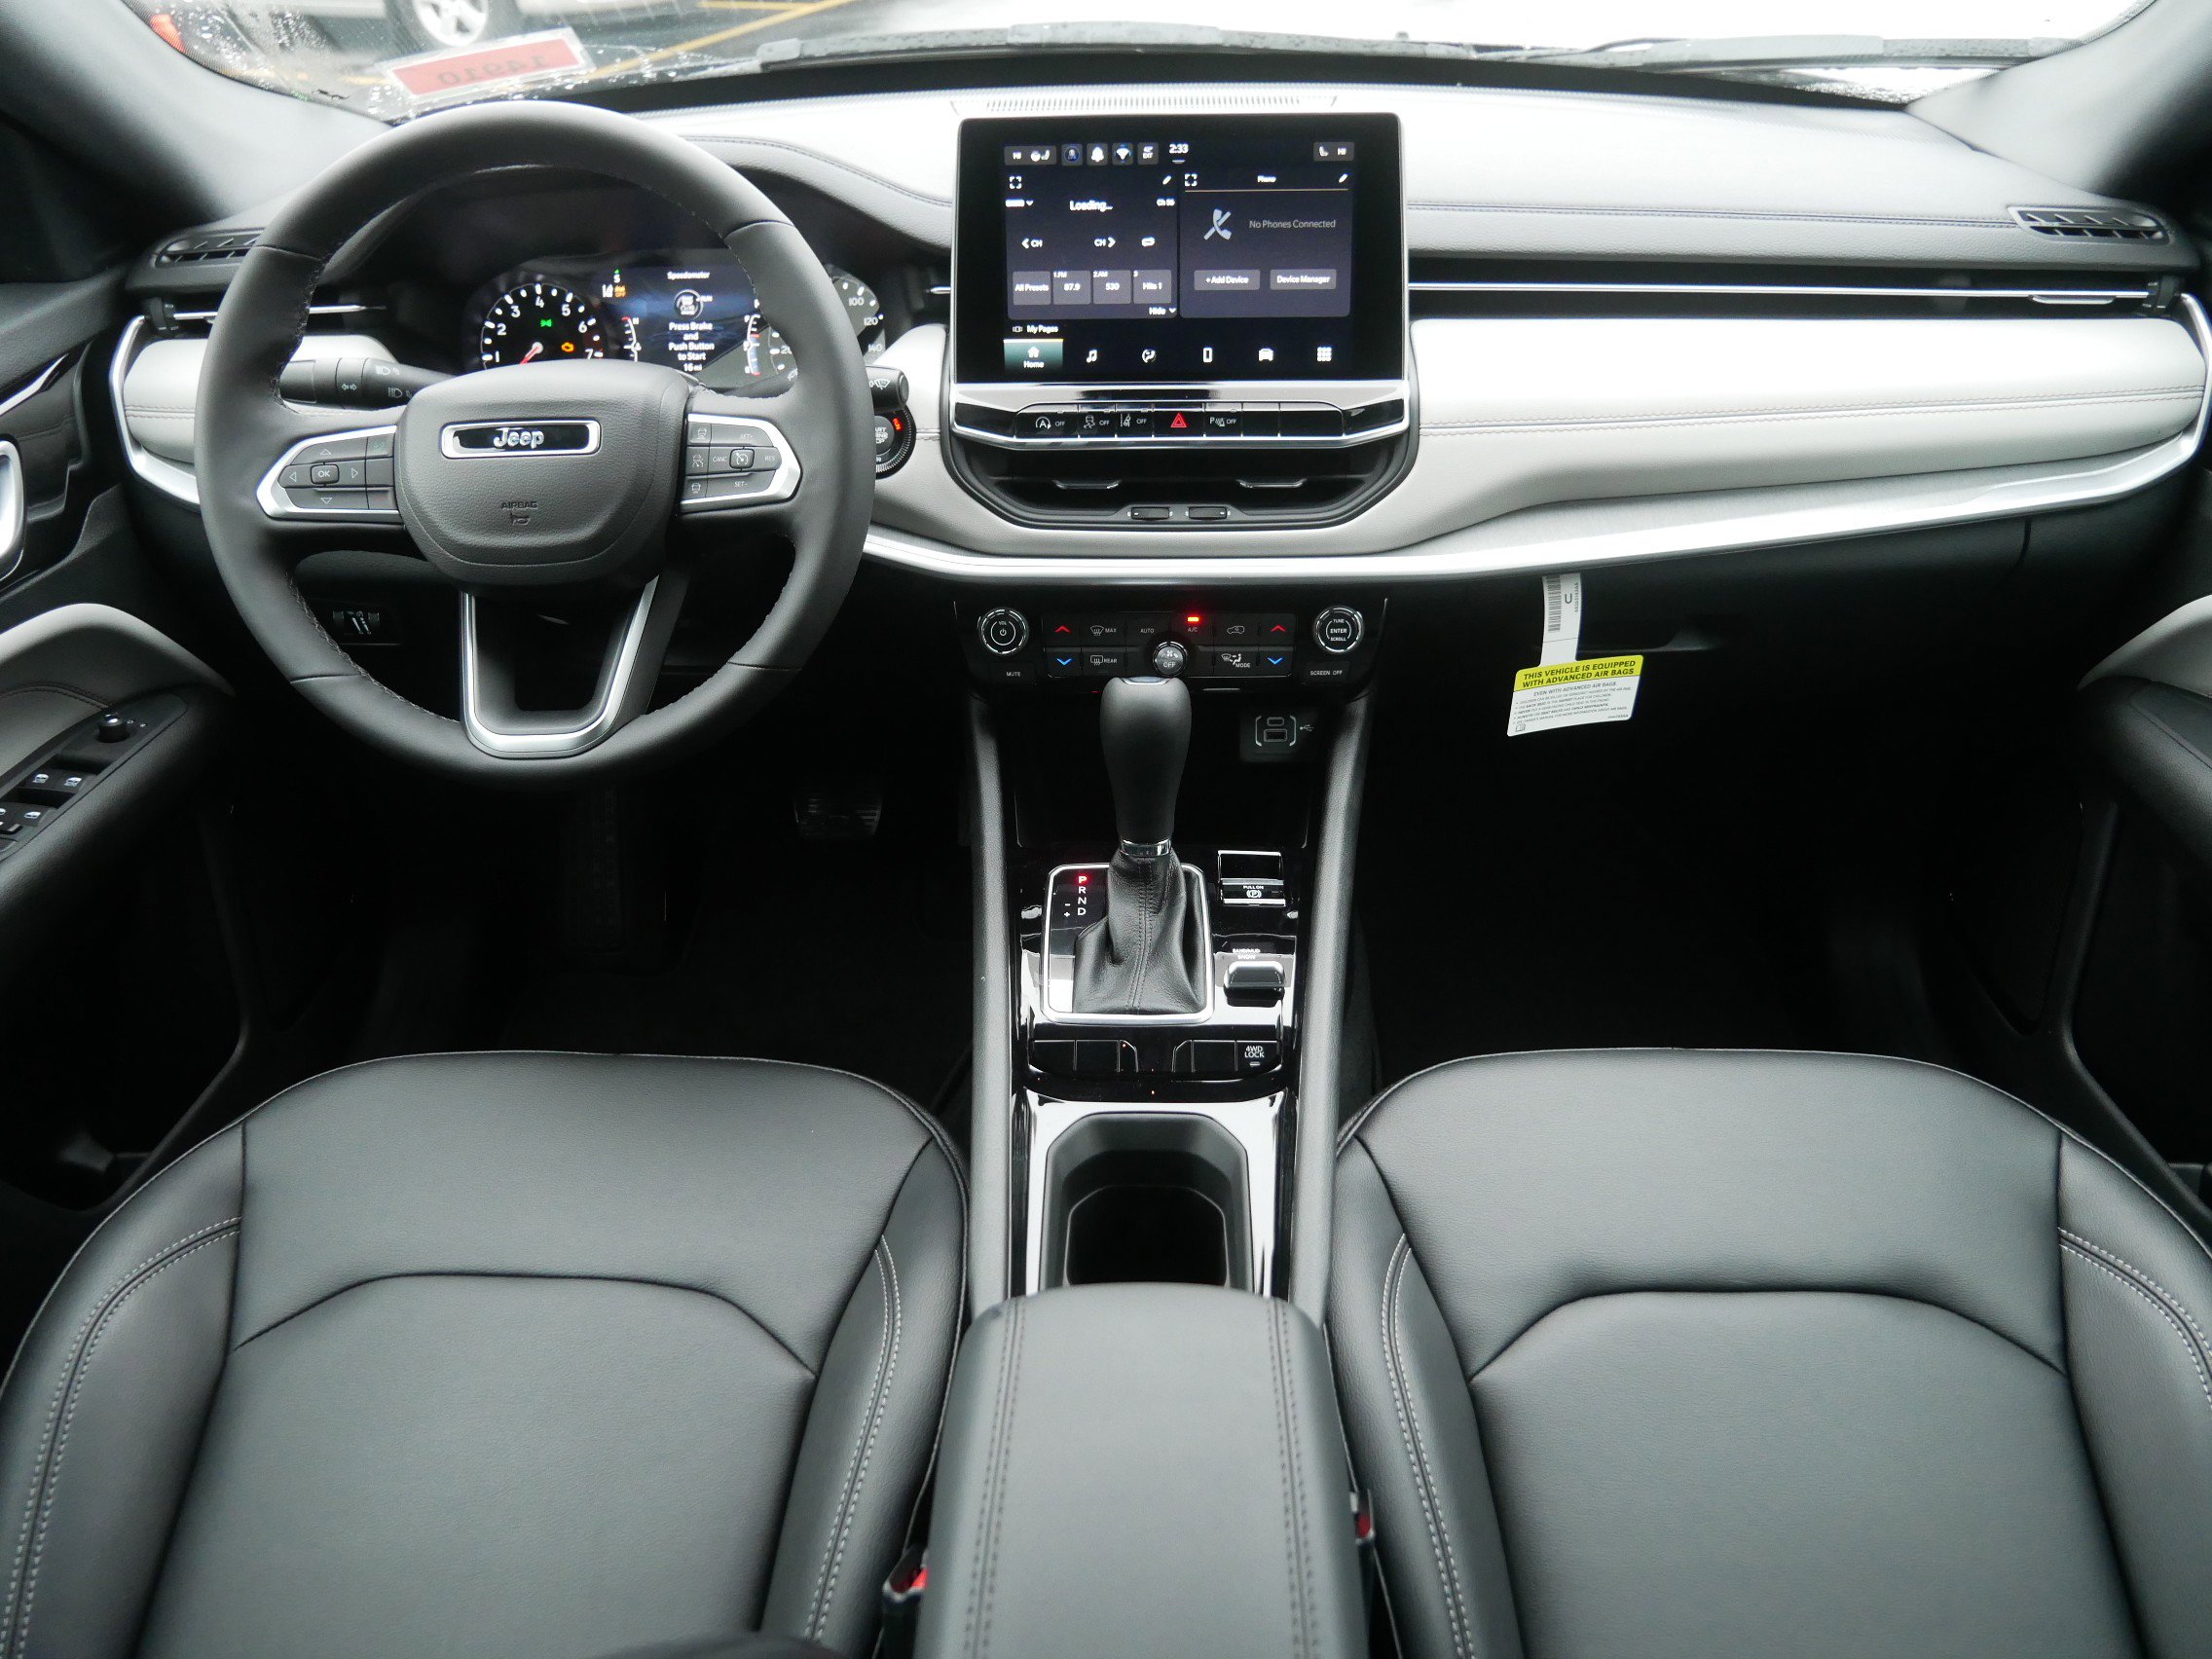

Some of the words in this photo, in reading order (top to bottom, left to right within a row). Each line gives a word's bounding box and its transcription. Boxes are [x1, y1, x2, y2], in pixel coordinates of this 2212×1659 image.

[1169, 143, 1189, 154] 2:33
[1262, 219, 1292, 228] Phones
[1293, 219, 1336, 228] Connected
[1094, 239, 1106, 247] CH
[1226, 276, 1249, 284] Device
[1277, 275, 1300, 283] Device
[1301, 275, 1330, 284] Manager
[535, 296, 544, 308] 4
[849, 297, 865, 307] 100
[510, 305, 521, 318] 3
[562, 304, 571, 316] 5
[690, 321, 714, 330] Brake
[864, 317, 878, 326] 120
[497, 323, 507, 336] 2
[578, 320, 587, 333] 6
[1026, 325, 1038, 334] My
[1039, 325, 1058, 334] Pages
[682, 332, 698, 341] and
[669, 342, 687, 350] Push
[585, 349, 594, 360] 7
[1024, 360, 1044, 369] Home
[493, 426, 544, 449] Jeep
[500, 500, 537, 509] AIRBAG
[1565, 593, 1572, 604] U
[1524, 671, 1542, 680] THIS
[1544, 666, 1580, 676] VEHICLE
[1592, 660, 1636, 670] EQUIPPED
[1522, 679, 1544, 687] WITH
[1546, 673, 1593, 684] ADVANCED
[1563, 683, 1591, 692] ADVANCED
